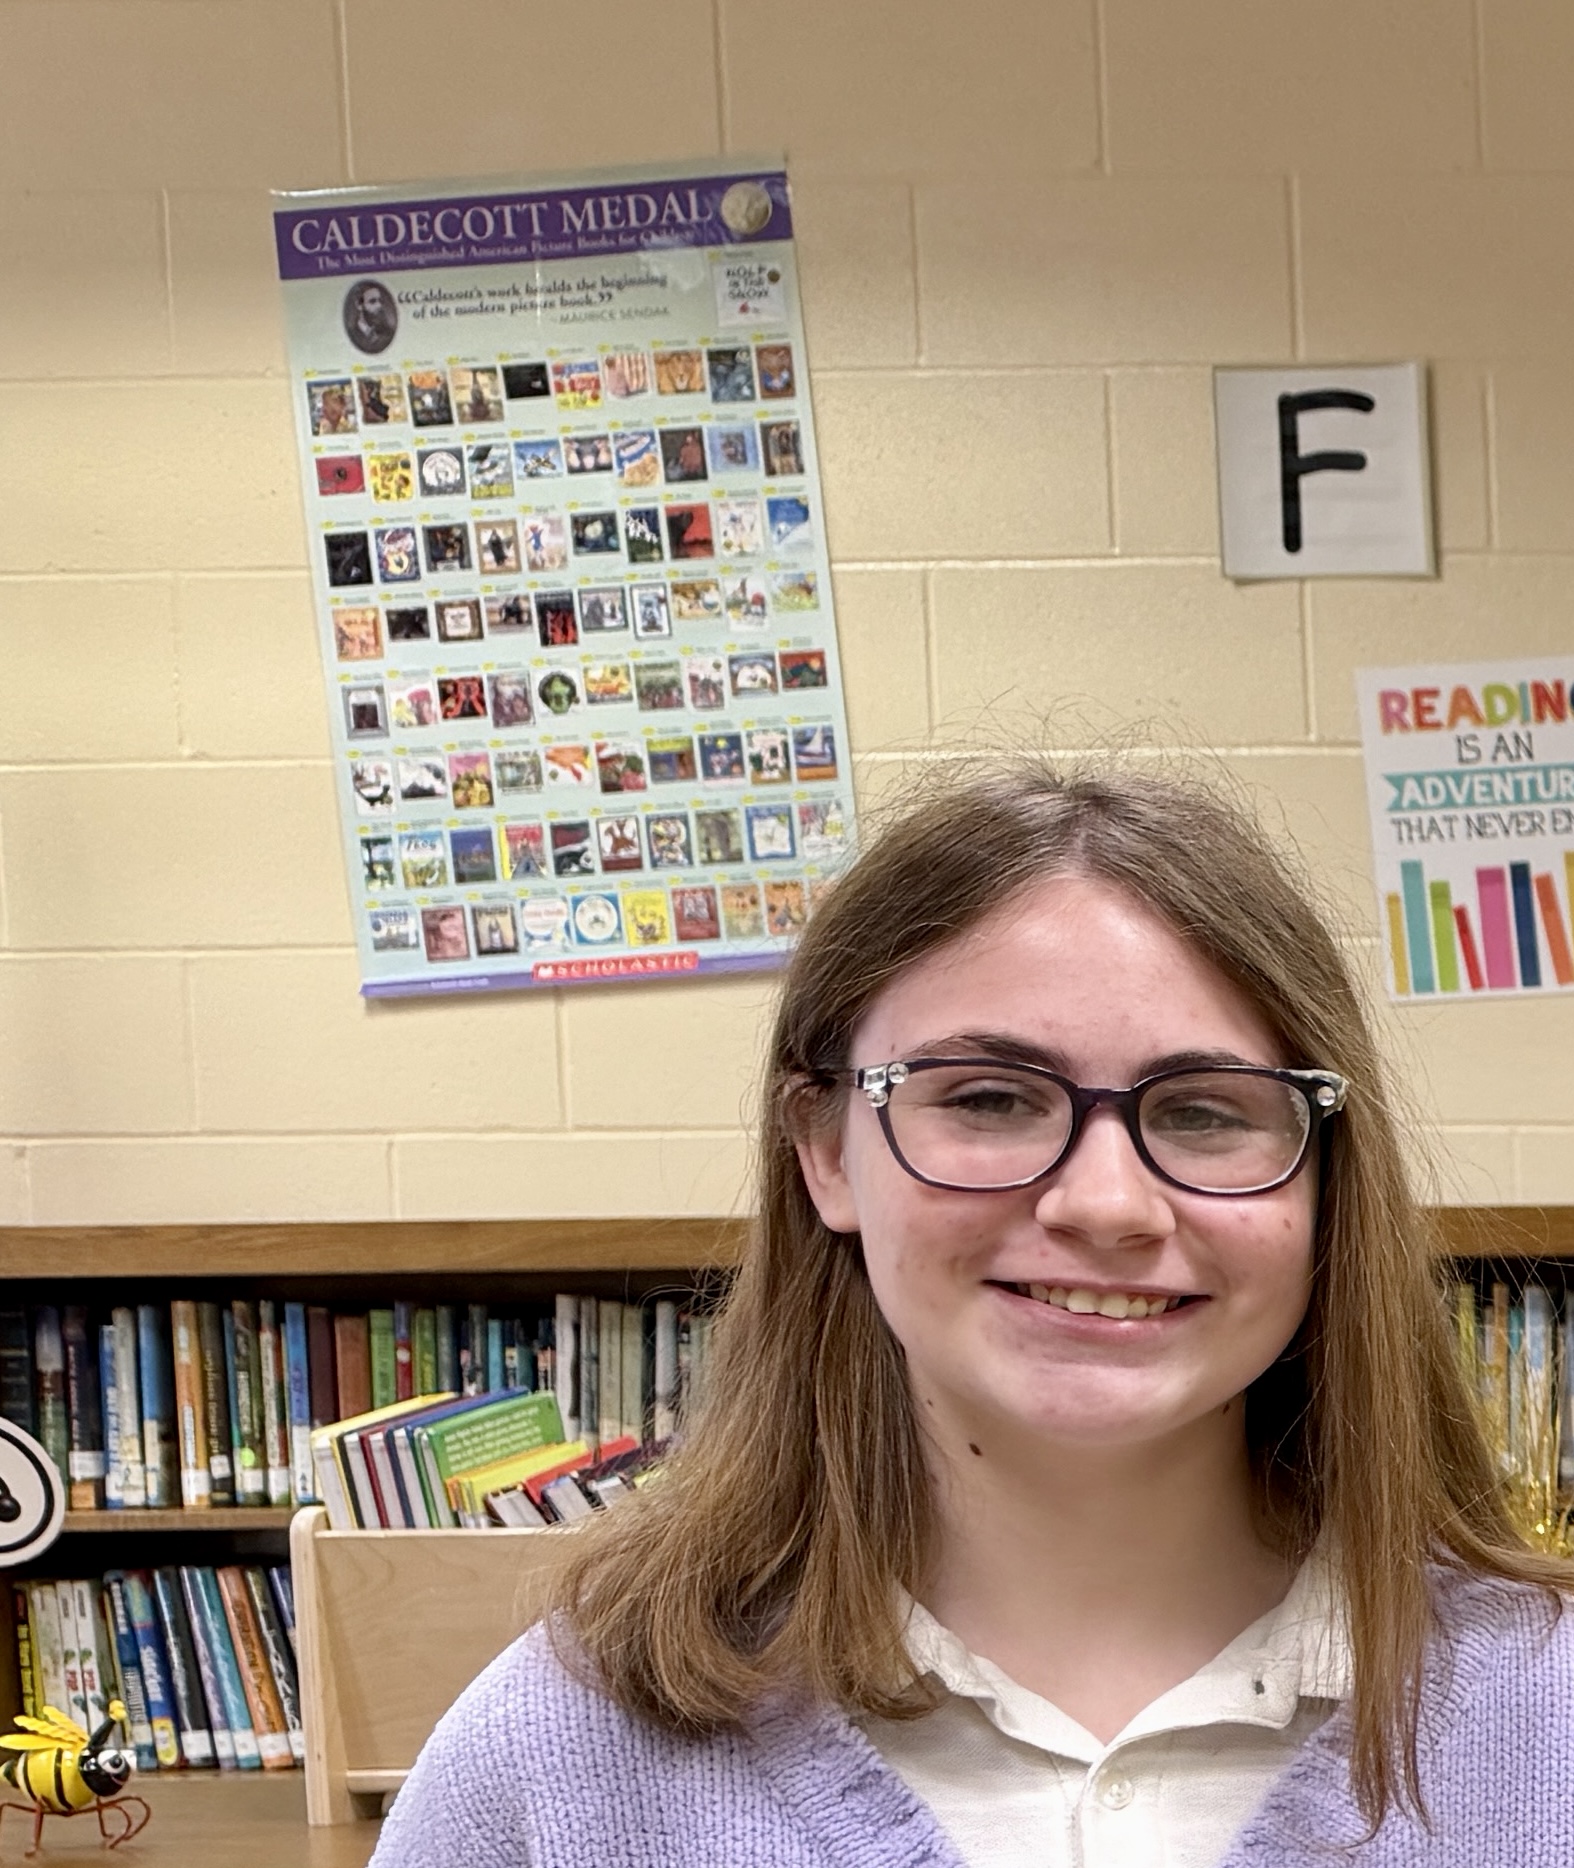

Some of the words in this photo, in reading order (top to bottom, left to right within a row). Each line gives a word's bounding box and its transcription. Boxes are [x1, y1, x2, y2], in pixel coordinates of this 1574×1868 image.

[292, 201, 548, 254] CALDECOTT
[560, 188, 713, 235] MEDAL
[317, 256, 341, 270] The
[344, 252, 376, 268] Most
[380, 245, 465, 266] Distinguished
[469, 240, 528, 258] American
[532, 237, 573, 254] Picture
[577, 234, 616, 250] Books
[486, 284, 521, 299] work
[525, 279, 572, 296] heralds
[576, 277, 597, 291] the
[601, 274, 668, 292] beginning
[412, 306, 426, 319] of
[430, 303, 452, 318] the
[455, 300, 506, 315] modern
[509, 296, 556, 314] picture
[558, 309, 616, 325] MAURICE
[620, 305, 669, 319] SENDAK
[1278, 388, 1376, 554] F
[1456, 734, 1481, 764] IS
[1491, 731, 1534, 762] AN
[1391, 815, 1458, 844] THAT
[1464, 809, 1546, 840] NEVER
[556, 954, 691, 977] SCHOLASTIC
